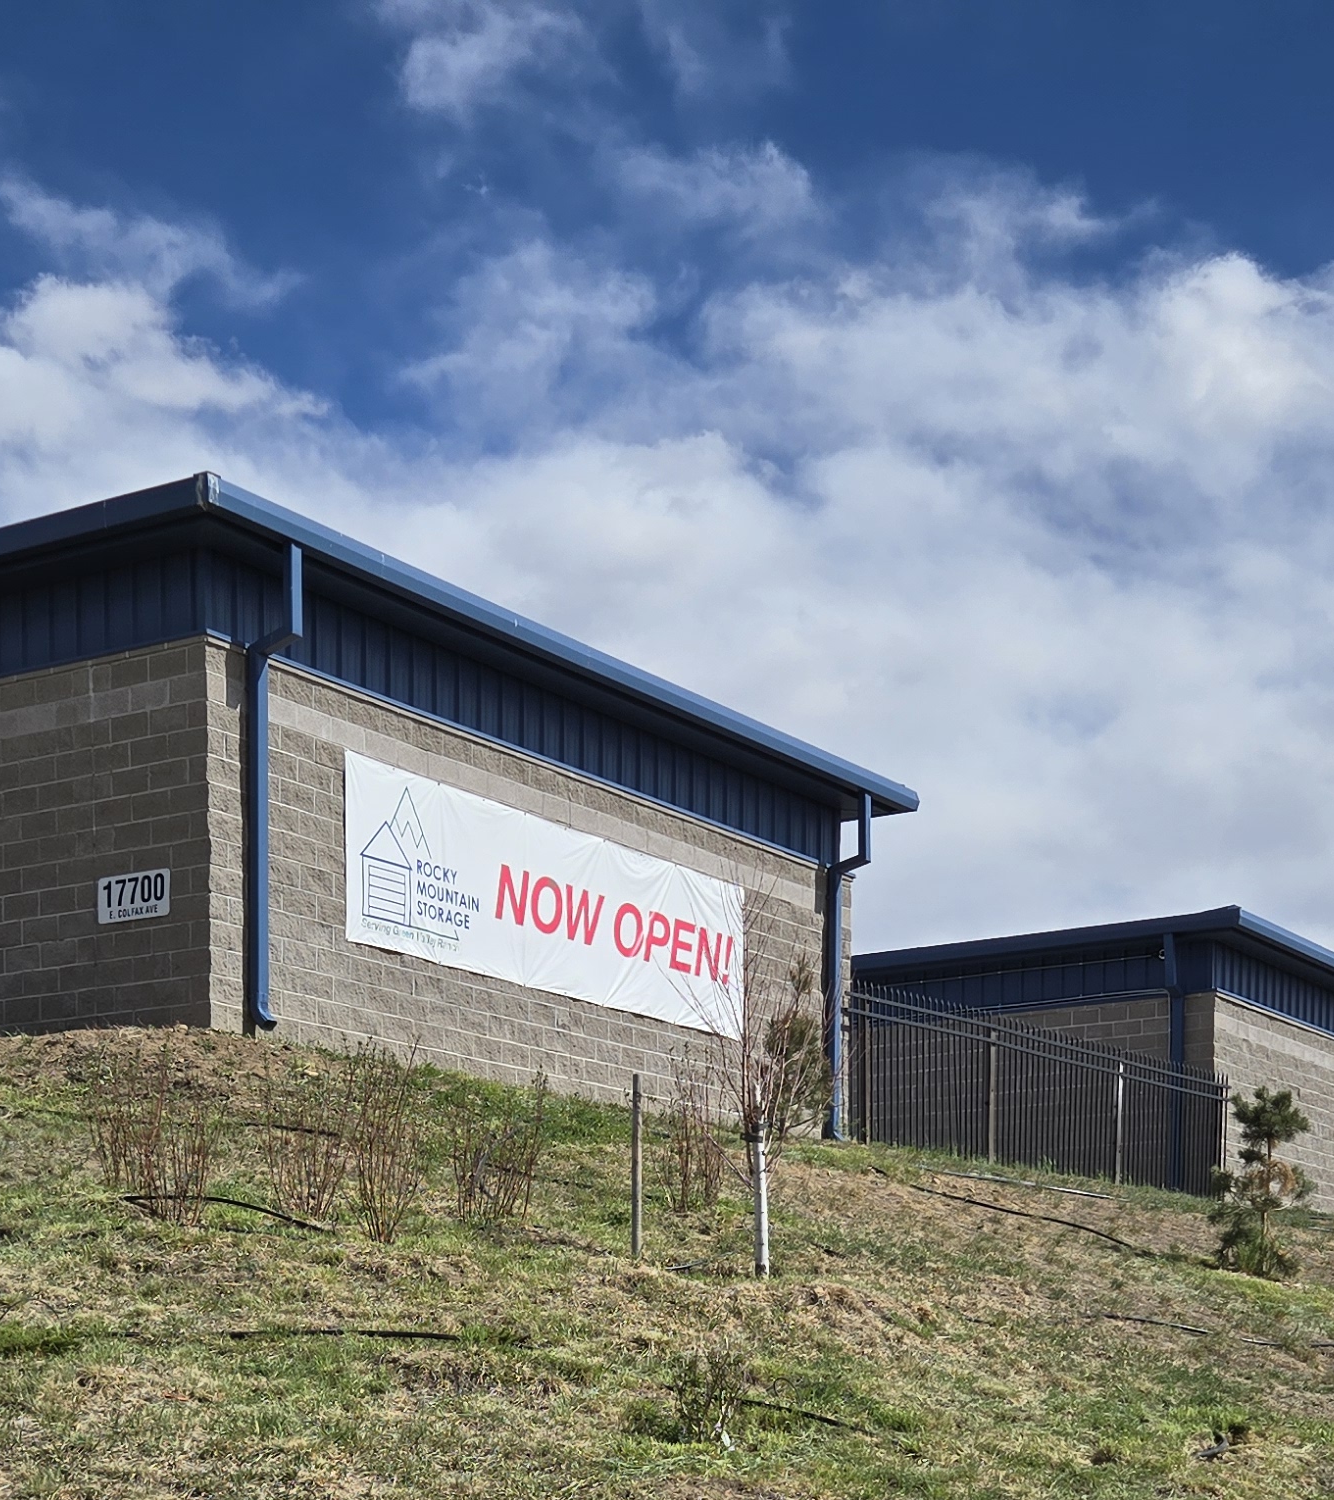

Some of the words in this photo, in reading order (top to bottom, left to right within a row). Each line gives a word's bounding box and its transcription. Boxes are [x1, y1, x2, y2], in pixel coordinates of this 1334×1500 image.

[416, 859, 457, 885] ROCKY
[103, 873, 164, 908] 17700
[416, 880, 479, 913] MOUNTAIN
[109, 910, 116, 920] E.
[118, 906, 144, 919] COLFAX
[145, 904, 158, 914] AVE
[416, 900, 470, 930] STORAGE
[495, 863, 605, 946] NOW
[613, 902, 734, 986] OPEN!
[361, 918, 392, 936] Serving
[392, 926, 415, 941] Geen
